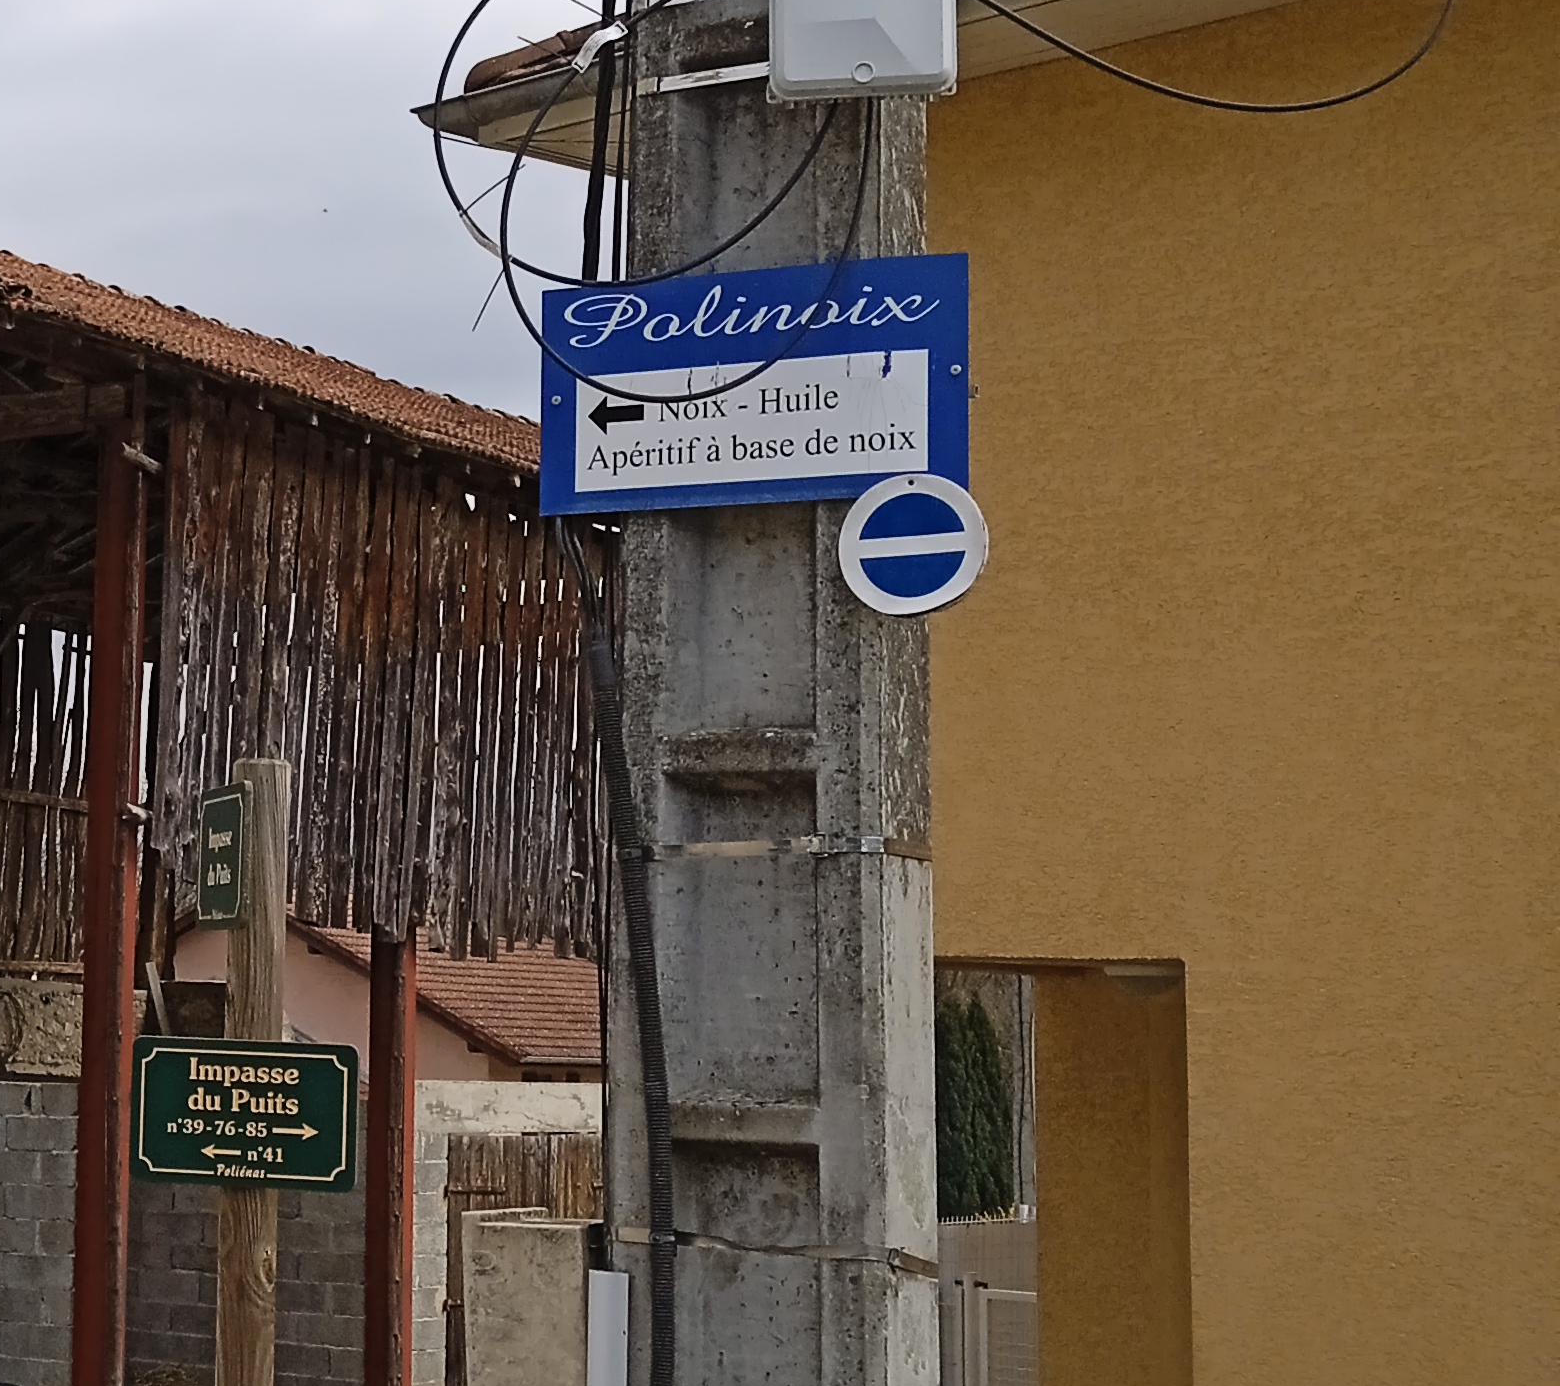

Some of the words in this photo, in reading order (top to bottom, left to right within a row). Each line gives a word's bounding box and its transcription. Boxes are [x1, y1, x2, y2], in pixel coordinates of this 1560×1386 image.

[563, 284, 941, 349] Polinoix
[658, 393, 729, 423] Noix
[758, 384, 840, 416] Huile
[586, 435, 699, 476] Apéritif
[705, 435, 723, 464] à
[730, 433, 796, 462] base
[804, 428, 840, 457] de
[847, 423, 918, 454] noix
[188, 1056, 301, 1088] Impasse
[187, 1086, 223, 1112] du
[230, 1088, 300, 1116] Puits
[215, 1163, 266, 1180] Poliénas
